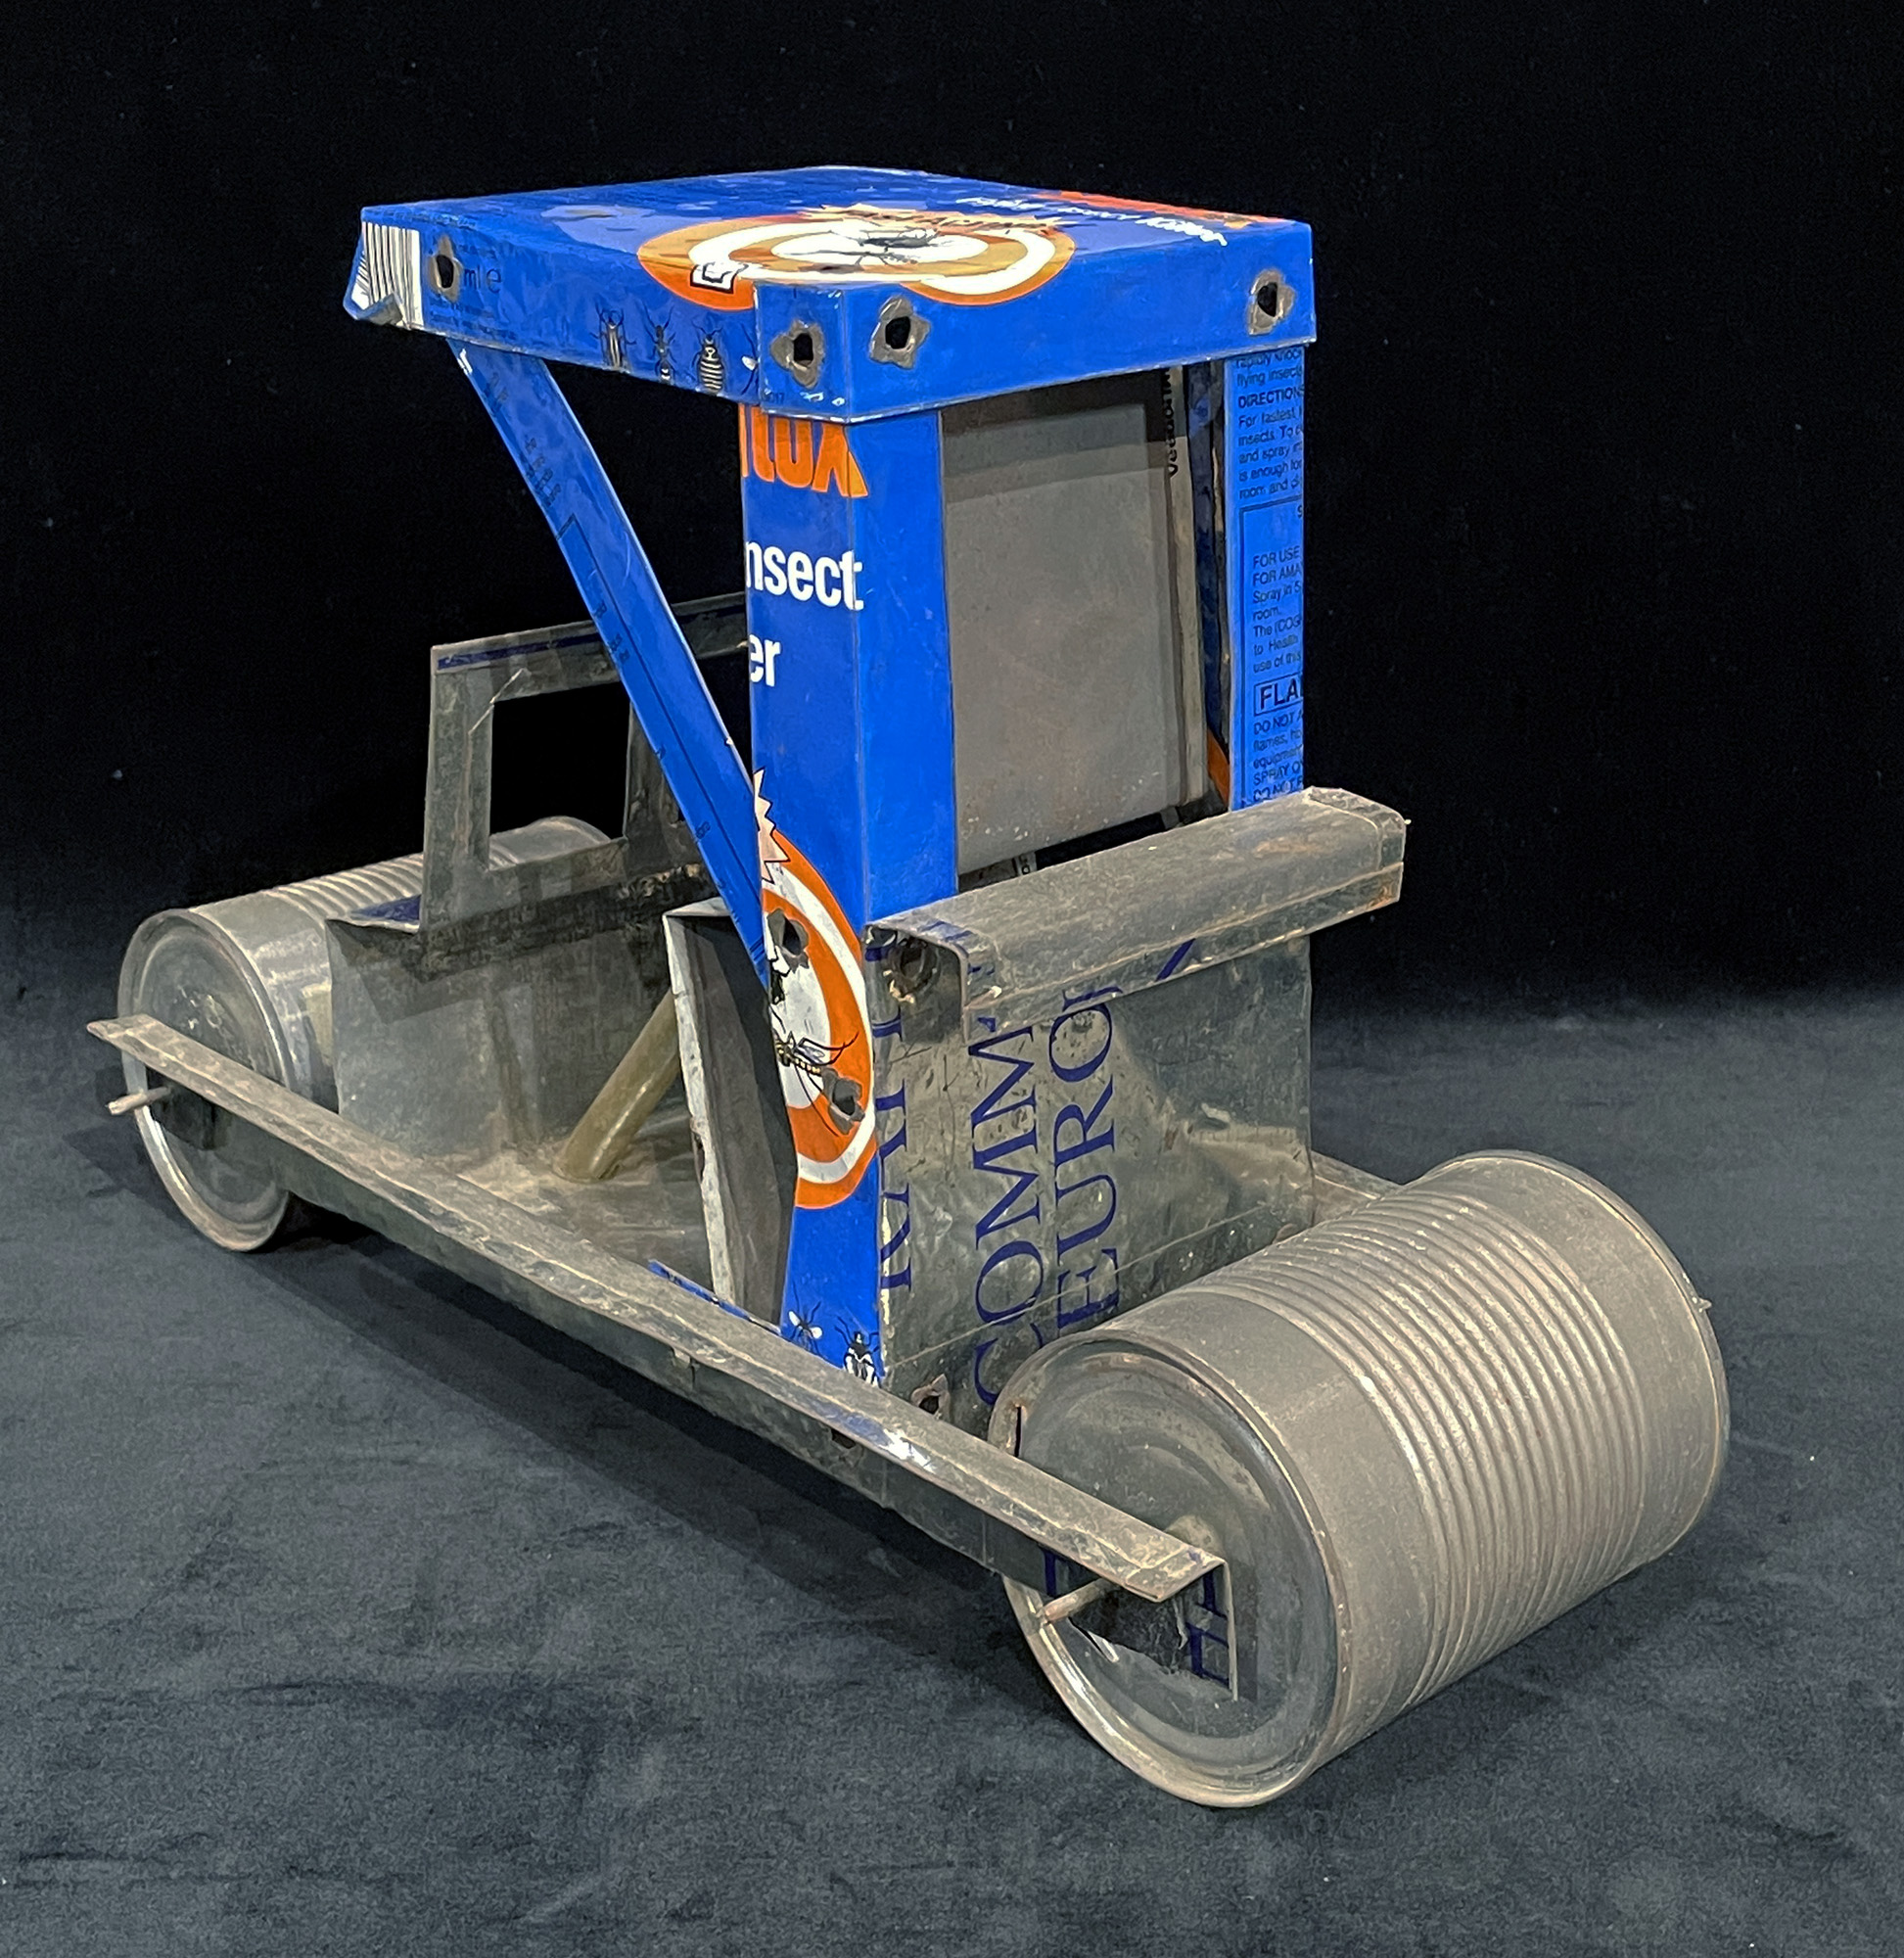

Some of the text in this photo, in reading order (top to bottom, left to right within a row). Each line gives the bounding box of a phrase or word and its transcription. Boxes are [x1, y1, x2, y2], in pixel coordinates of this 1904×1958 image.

[1253, 544, 1300, 569] FOR USE
[1253, 569, 1277, 586] FOR
[1259, 676, 1304, 711] FLA
[1253, 720, 1272, 735] DO
[1273, 712, 1294, 728] NOT
[967, 1015, 1045, 1407] COMM
